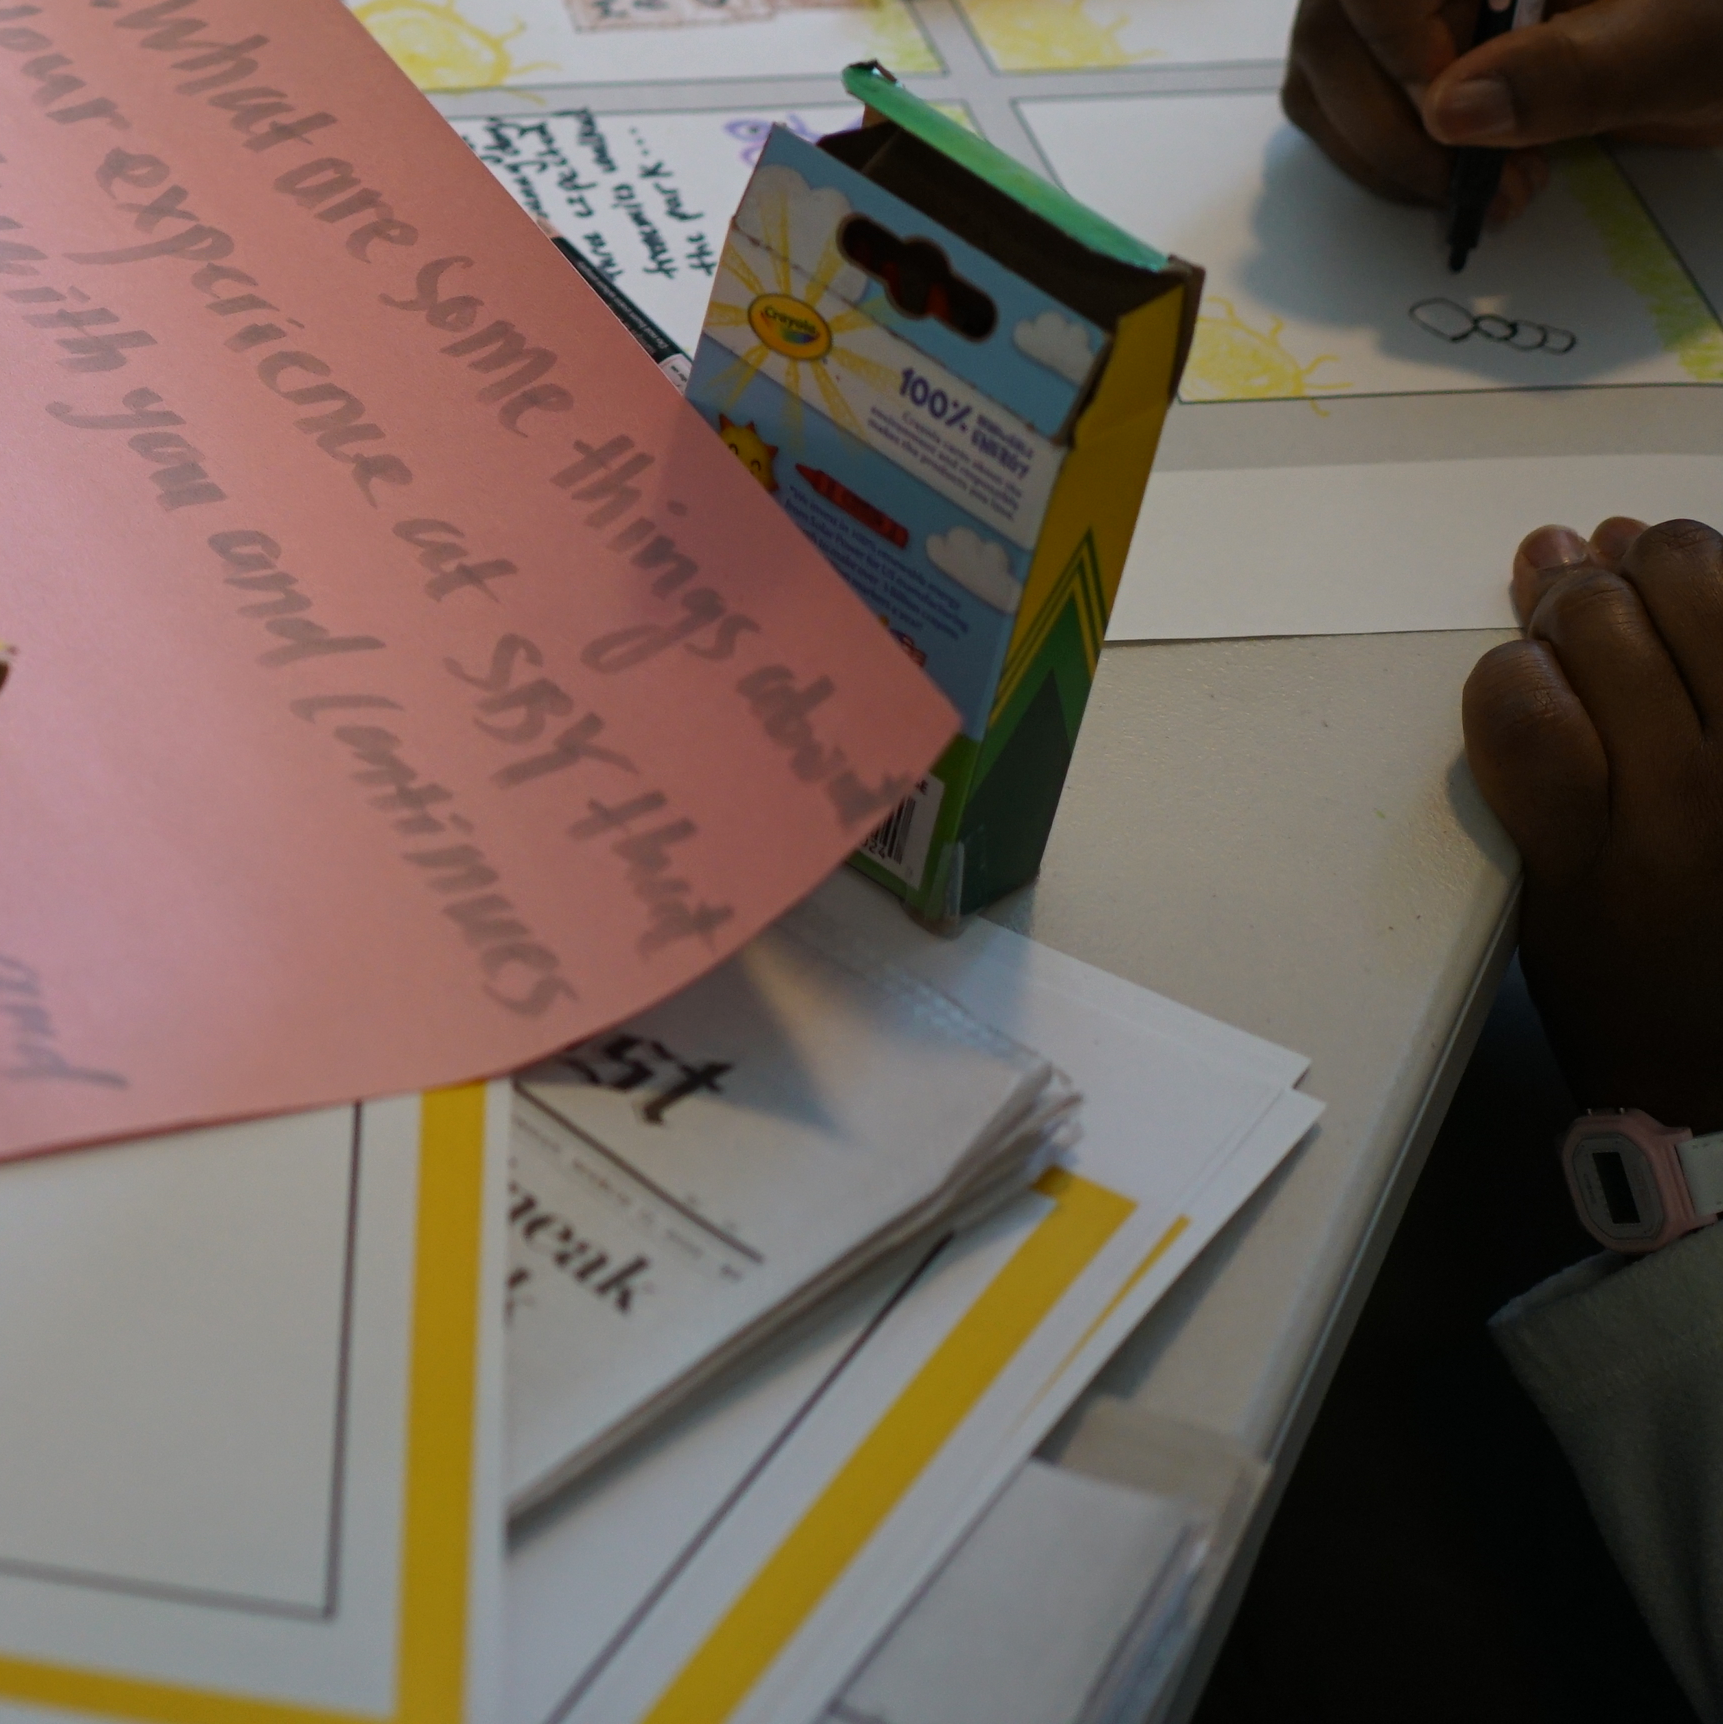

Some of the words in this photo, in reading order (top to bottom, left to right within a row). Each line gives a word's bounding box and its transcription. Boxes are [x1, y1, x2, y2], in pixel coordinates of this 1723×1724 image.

[685, 232, 719, 278] the
[764, 304, 820, 338] Crayola
[272, 152, 419, 264] are
[377, 254, 575, 440] some
[551, 433, 760, 671] things
[897, 365, 969, 433] 100%
[43, 386, 233, 513] you
[206, 526, 390, 669] and
[392, 516, 519, 607] at
[568, 788, 738, 962] that
